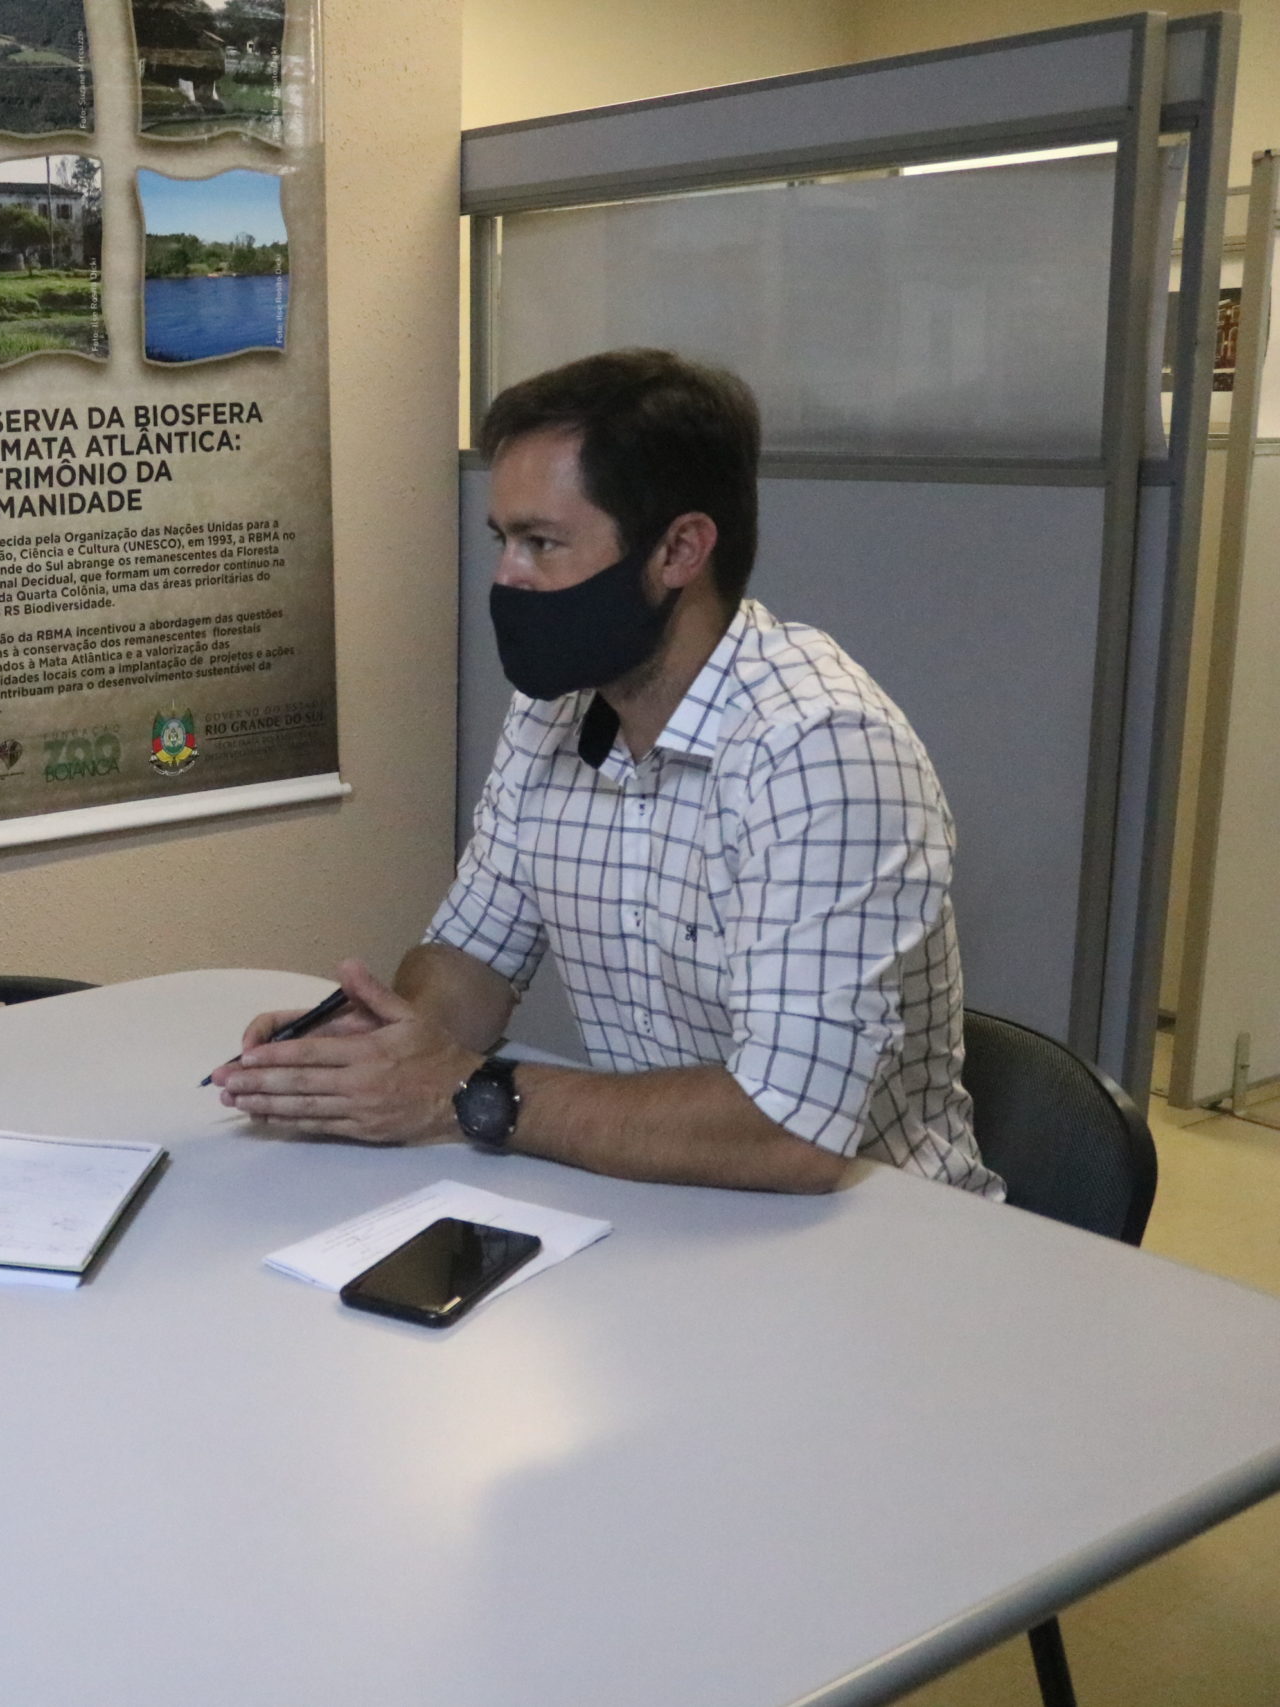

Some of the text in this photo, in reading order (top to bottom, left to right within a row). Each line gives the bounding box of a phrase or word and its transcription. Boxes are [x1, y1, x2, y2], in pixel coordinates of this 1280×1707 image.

[87, 406, 124, 429] DA
[134, 401, 262, 429] BIOSFERA
[1, 436, 74, 461] MATA
[86, 429, 239, 457] ATLÂNTICA:
[136, 460, 172, 482] DA
[19, 546, 63, 559] Ciência
[67, 547, 74, 555] e
[77, 543, 119, 554] Cultura
[123, 538, 184, 552] (UNESCO),
[187, 538, 204, 547] em
[207, 534, 235, 545] 1993,
[238, 535, 244, 543] a
[248, 531, 279, 542] RBMA
[282, 531, 295, 540] no
[35, 533, 60, 546] pela
[64, 527, 137, 543] Organização
[140, 526, 160, 537] das
[163, 523, 204, 536] Nações
[207, 521, 243, 532] Unidas
[246, 520, 269, 531] para
[272, 520, 279, 528] a
[26, 562, 41, 572] do
[45, 559, 63, 571] Sul
[67, 558, 114, 569] abrange
[118, 557, 131, 565] os
[134, 550, 217, 564] remanescentes
[220, 547, 233, 558] da
[236, 544, 279, 556] Floresta
[16, 589, 57, 601] Quarta
[60, 584, 108, 597] Colônia,
[112, 583, 136, 593] uma
[139, 580, 159, 590] das
[162, 578, 191, 589] áreas
[195, 572, 253, 588] prioritárias
[256, 570, 270, 580] do
[21, 572, 76, 587] Decidual,
[79, 573, 101, 584] que
[105, 569, 149, 580] formam
[153, 567, 169, 576] um
[173, 562, 220, 574] corredor
[223, 559, 270, 570] contínuo
[272, 558, 285, 567] na
[4, 605, 19, 616] RS
[24, 597, 114, 614] Biodiversidade.
[12, 645, 19, 656] à
[22, 638, 96, 655] conservação
[100, 637, 120, 647] dos
[124, 629, 206, 645] remanescentes
[212, 622, 261, 637] florestais
[18, 632, 32, 642] da
[36, 627, 72, 640] RBMA
[76, 623, 135, 636] incentivou
[138, 622, 145, 630] a
[149, 616, 211, 630] abordagem
[214, 613, 233, 623] das
[236, 608, 283, 623] questões
[28, 658, 35, 669] à
[38, 656, 67, 667] Mata
[71, 651, 122, 664] Atlântica
[125, 651, 132, 659] e
[135, 650, 142, 658] a
[145, 641, 208, 656] valorização
[211, 639, 230, 650] das
[206, 724, 226, 736] RIO
[231, 717, 280, 733] GRANDE
[285, 715, 301, 724] DO
